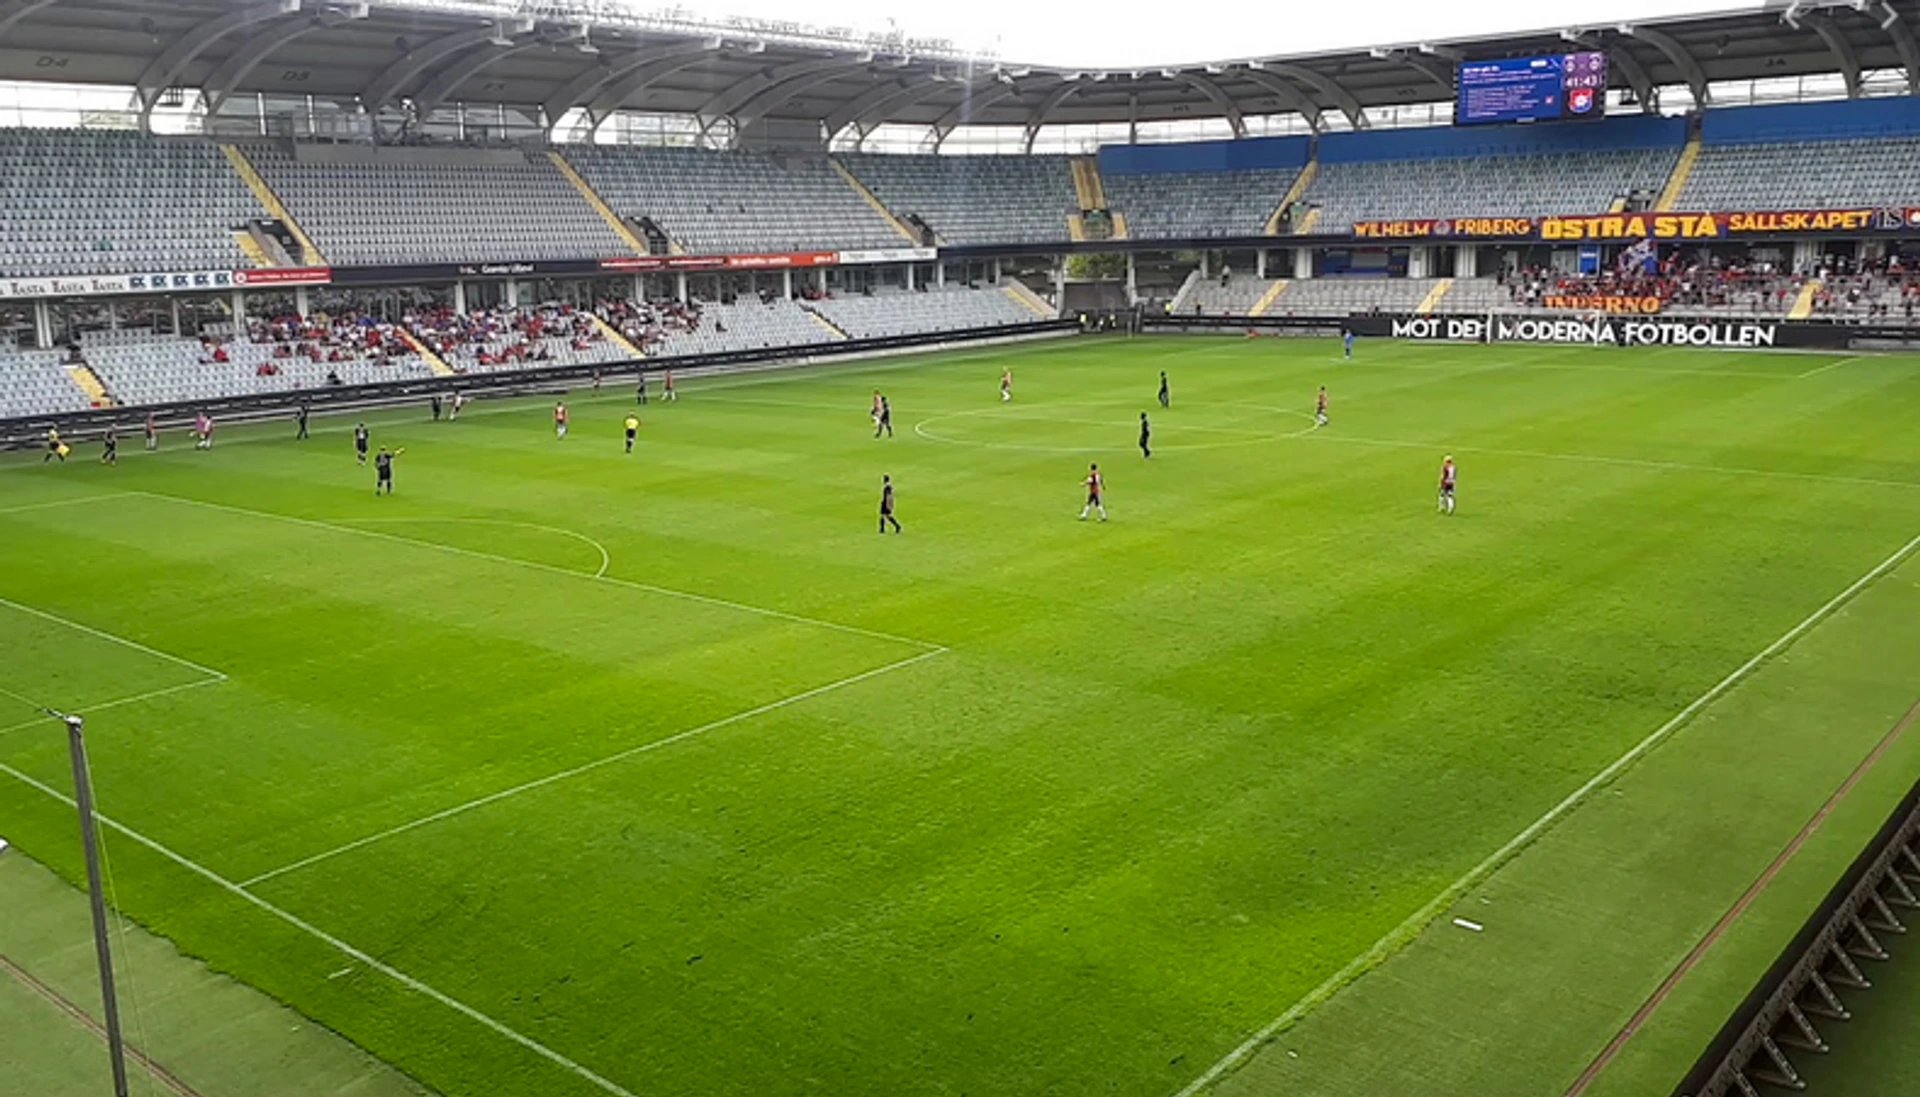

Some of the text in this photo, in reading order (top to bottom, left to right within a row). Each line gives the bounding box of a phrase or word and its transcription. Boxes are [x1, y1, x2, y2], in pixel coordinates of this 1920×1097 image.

[1353, 221, 1430, 237] WILHELM
[1454, 218, 1530, 235] FRIBERG
[1541, 215, 1647, 239] ÖSTRA
[1728, 210, 1873, 230] SÄLLSKAPET
[1391, 319, 1442, 337] MOT
[1499, 320, 1615, 342] MODERNA
[1625, 323, 1775, 346] FOTBOLLEN
